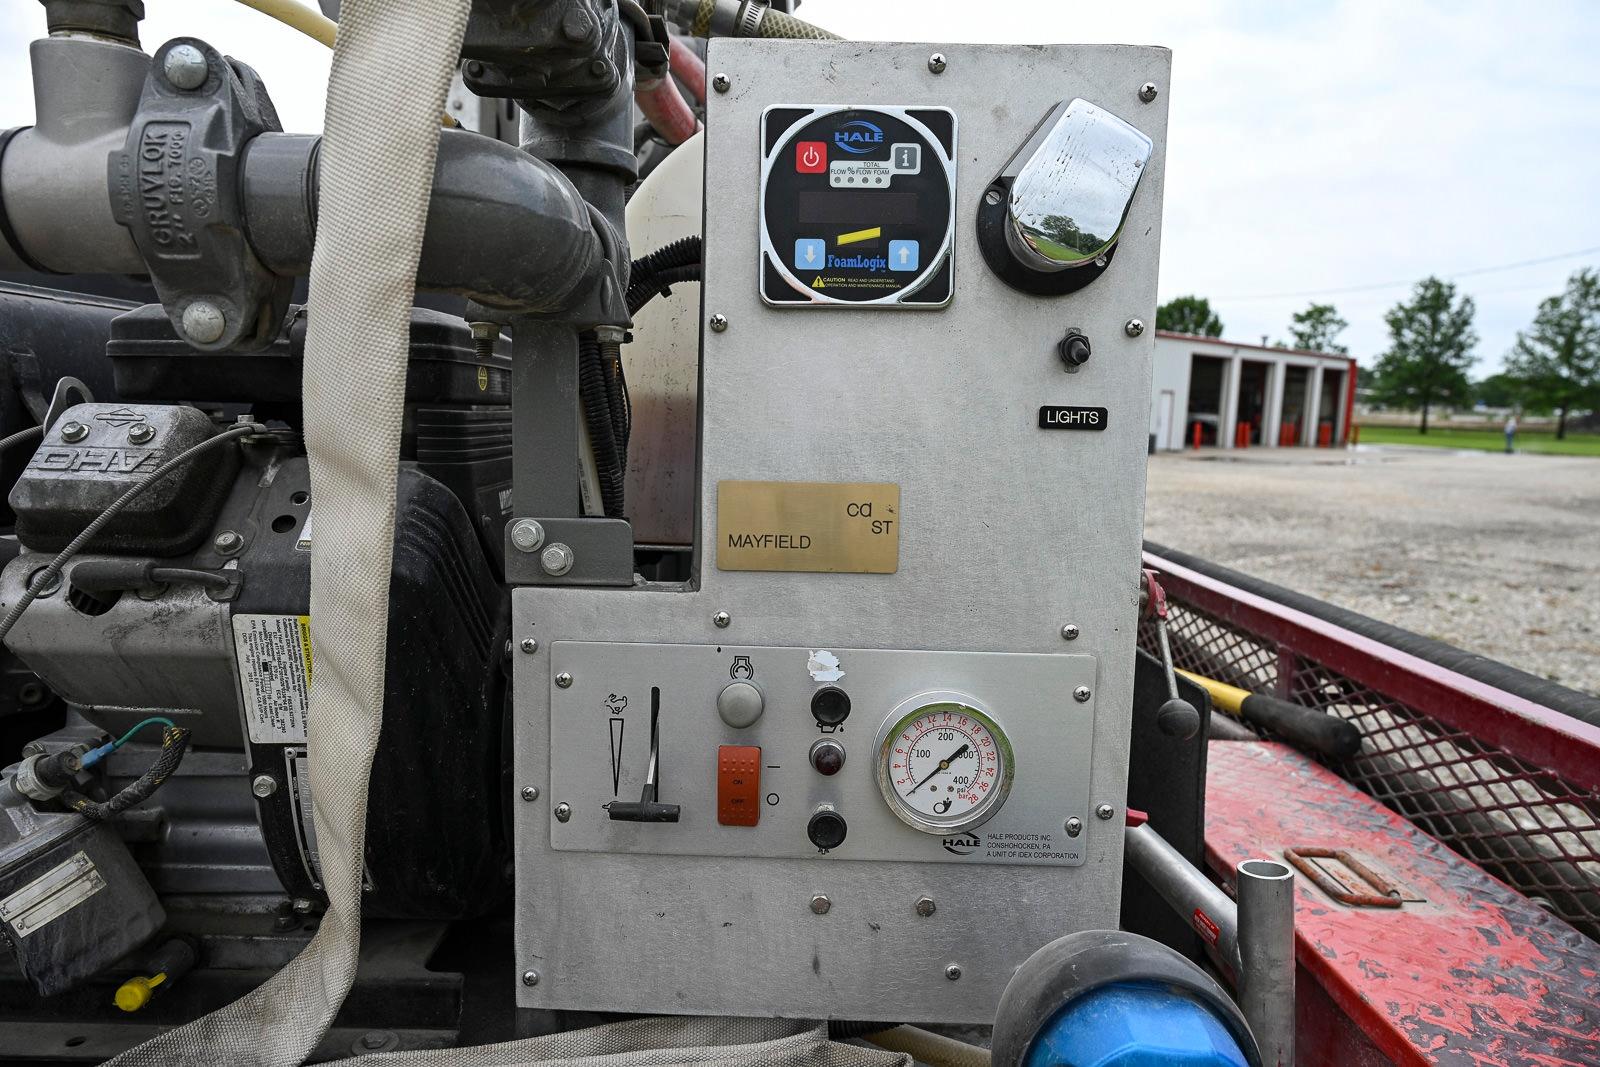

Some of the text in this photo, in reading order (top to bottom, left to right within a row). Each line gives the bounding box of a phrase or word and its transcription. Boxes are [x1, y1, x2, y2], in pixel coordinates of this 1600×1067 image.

[834, 132, 884, 142] HALE
[847, 167, 856, 175] %
[140, 132, 171, 244] GRUVLOK
[827, 254, 886, 272] FoamLogix
[1047, 410, 1099, 424] LIGHTS
[871, 520, 893, 535] ST
[728, 534, 811, 549] MAYFIELD
[927, 714, 937, 724] 12
[942, 713, 952, 722] 14
[958, 716, 968, 726] 16
[912, 720, 924, 731] 10
[971, 723, 982, 734] 18
[902, 733, 910, 741] 8
[937, 732, 954, 741] 200
[980, 736, 992, 747] 20
[915, 749, 931, 758] 100
[986, 751, 996, 762] 22
[985, 767, 995, 777] 24
[953, 776, 969, 784] 400
[978, 781, 989, 792] 26
[967, 793, 979, 805] 28
[943, 838, 981, 847] HALE
[1040, 834, 1053, 842] INC.
